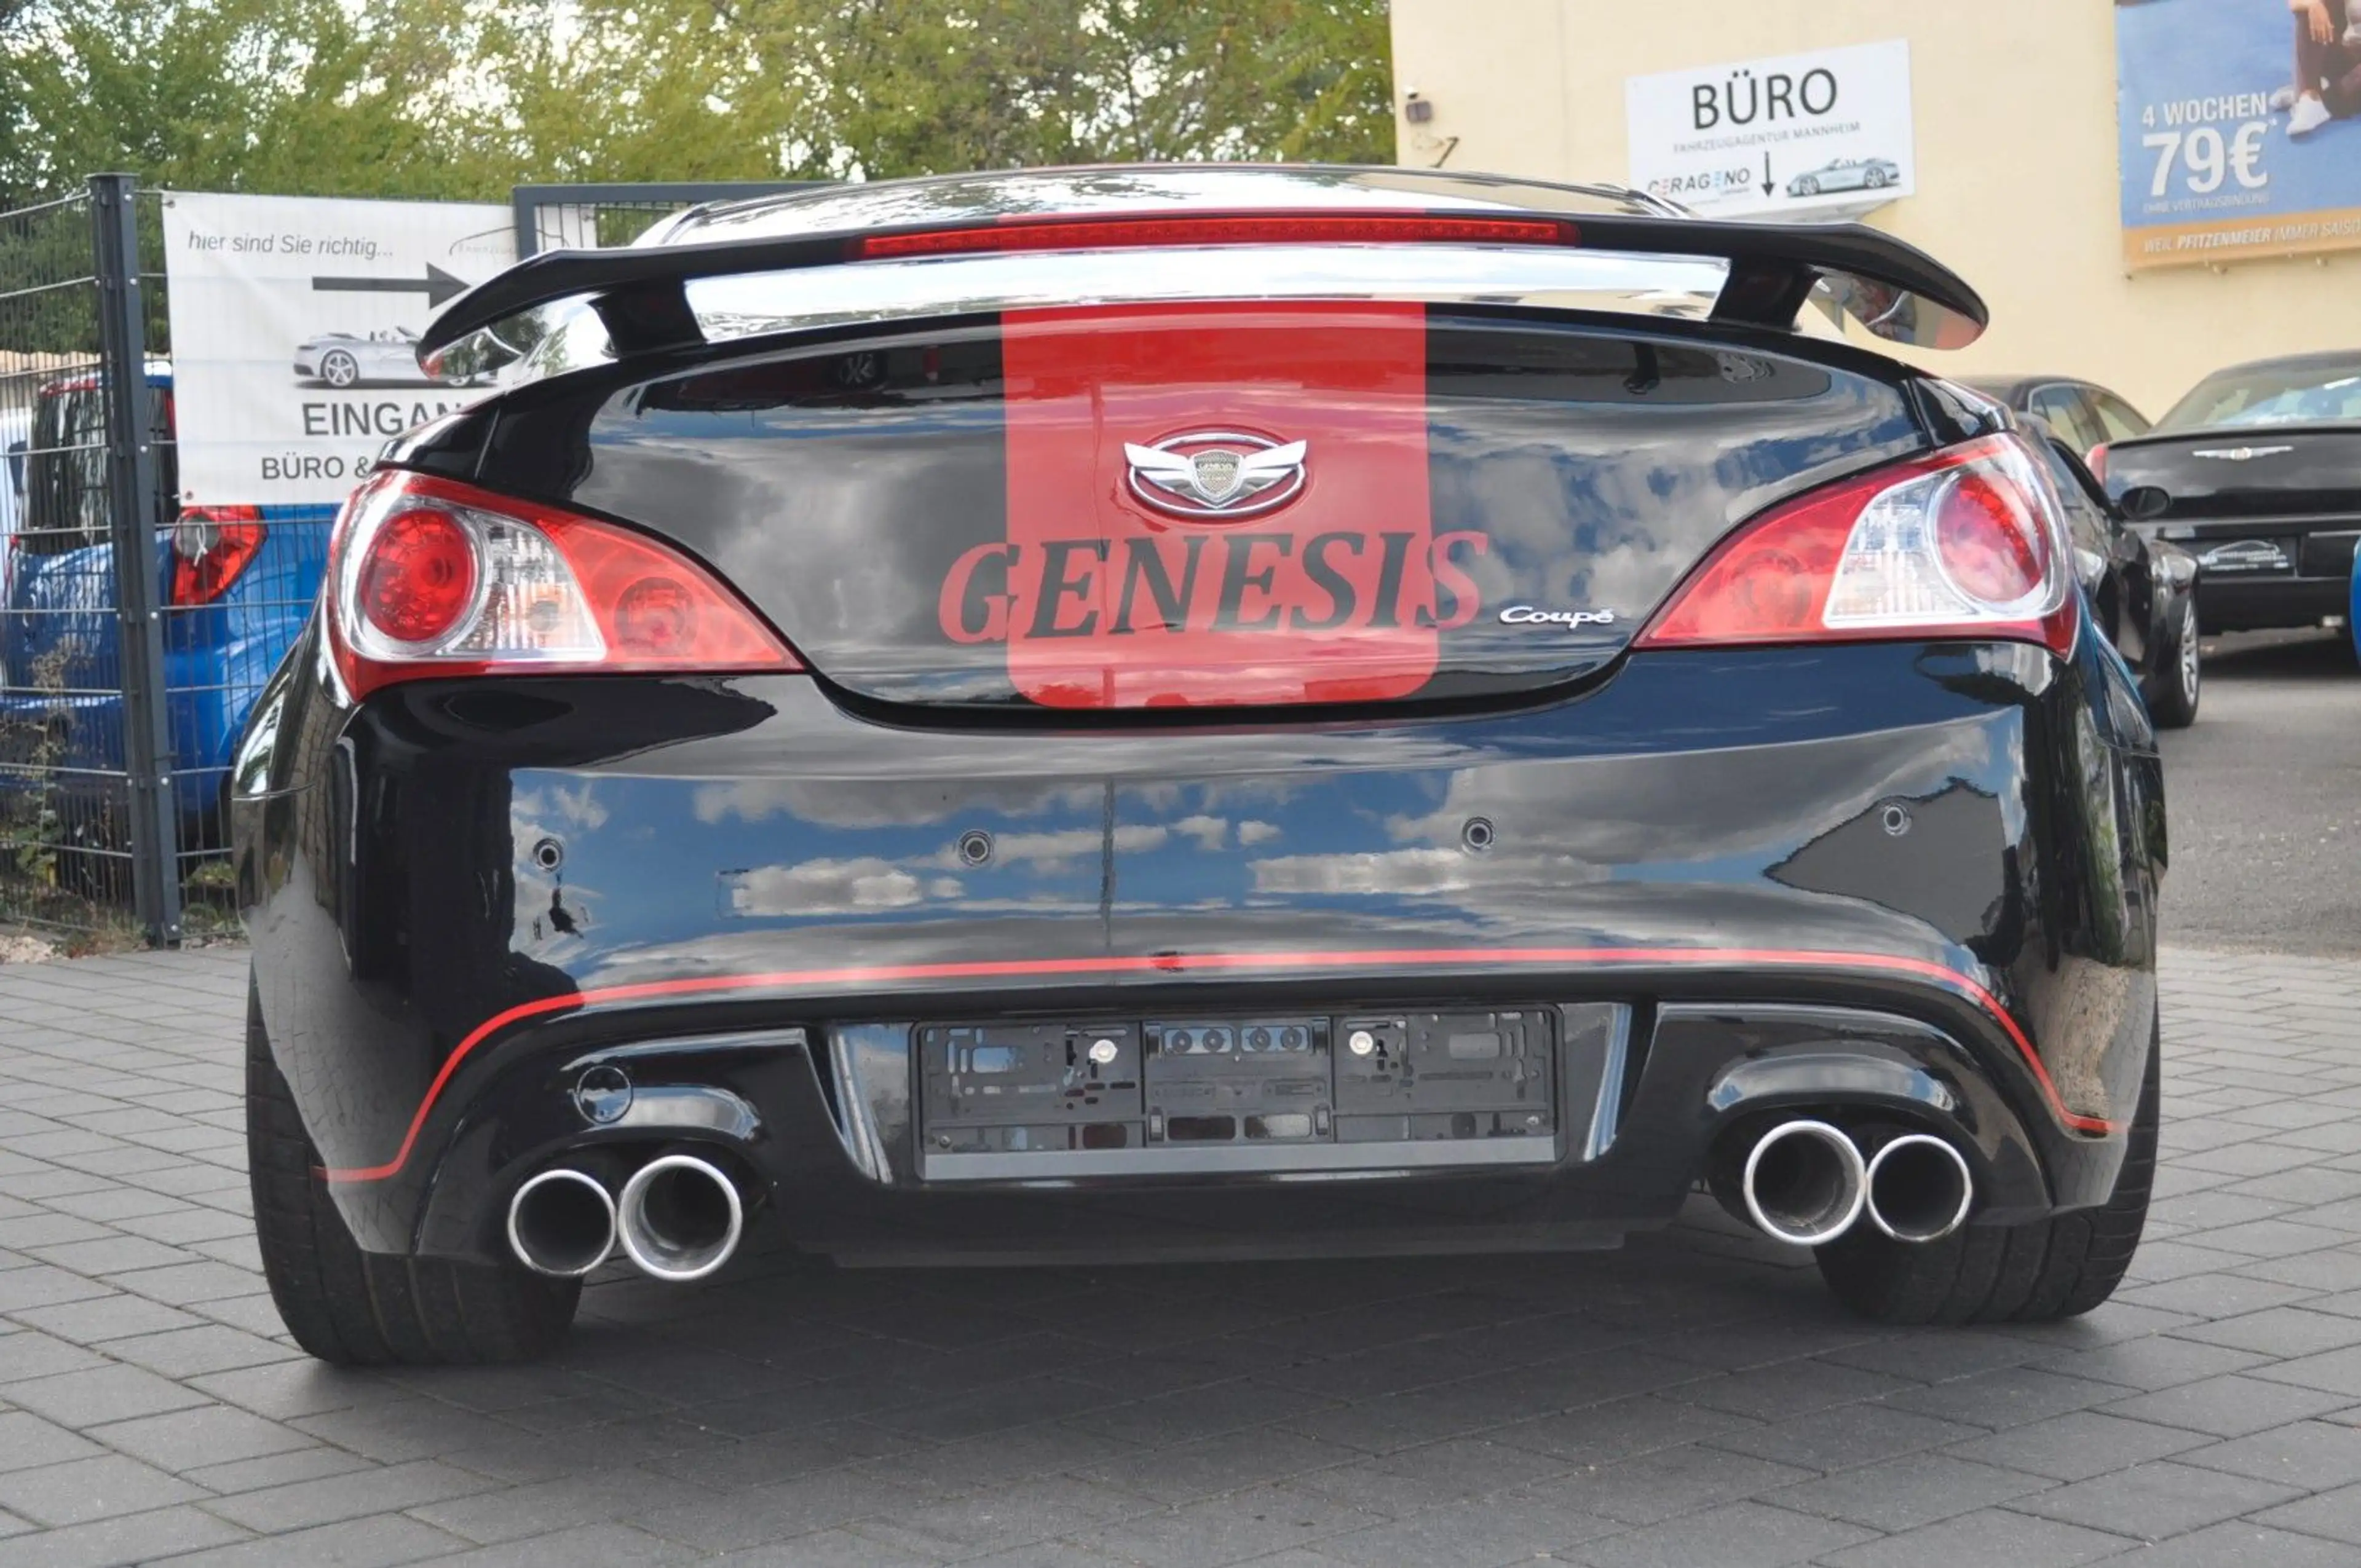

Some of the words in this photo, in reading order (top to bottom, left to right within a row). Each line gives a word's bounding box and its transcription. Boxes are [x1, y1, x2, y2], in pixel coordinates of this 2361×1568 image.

[1693, 68, 1838, 130] BÜRO
[2142, 105, 2155, 128] 4
[2163, 91, 2267, 126] WOCHEN
[1673, 130, 1790, 153] FAHRZEUGAGENTUR
[1793, 121, 1861, 139] MANNHEIM
[189, 230, 226, 251] hier
[232, 233, 274, 254] sind
[280, 235, 312, 255] Sie
[318, 237, 394, 261] richtig...
[2177, 227, 2271, 249] PFITZENMEIER
[302, 403, 461, 436] EINGA
[262, 451, 344, 479] BÜRO
[354, 456, 370, 478] &
[939, 531, 1487, 644] GENESIS
